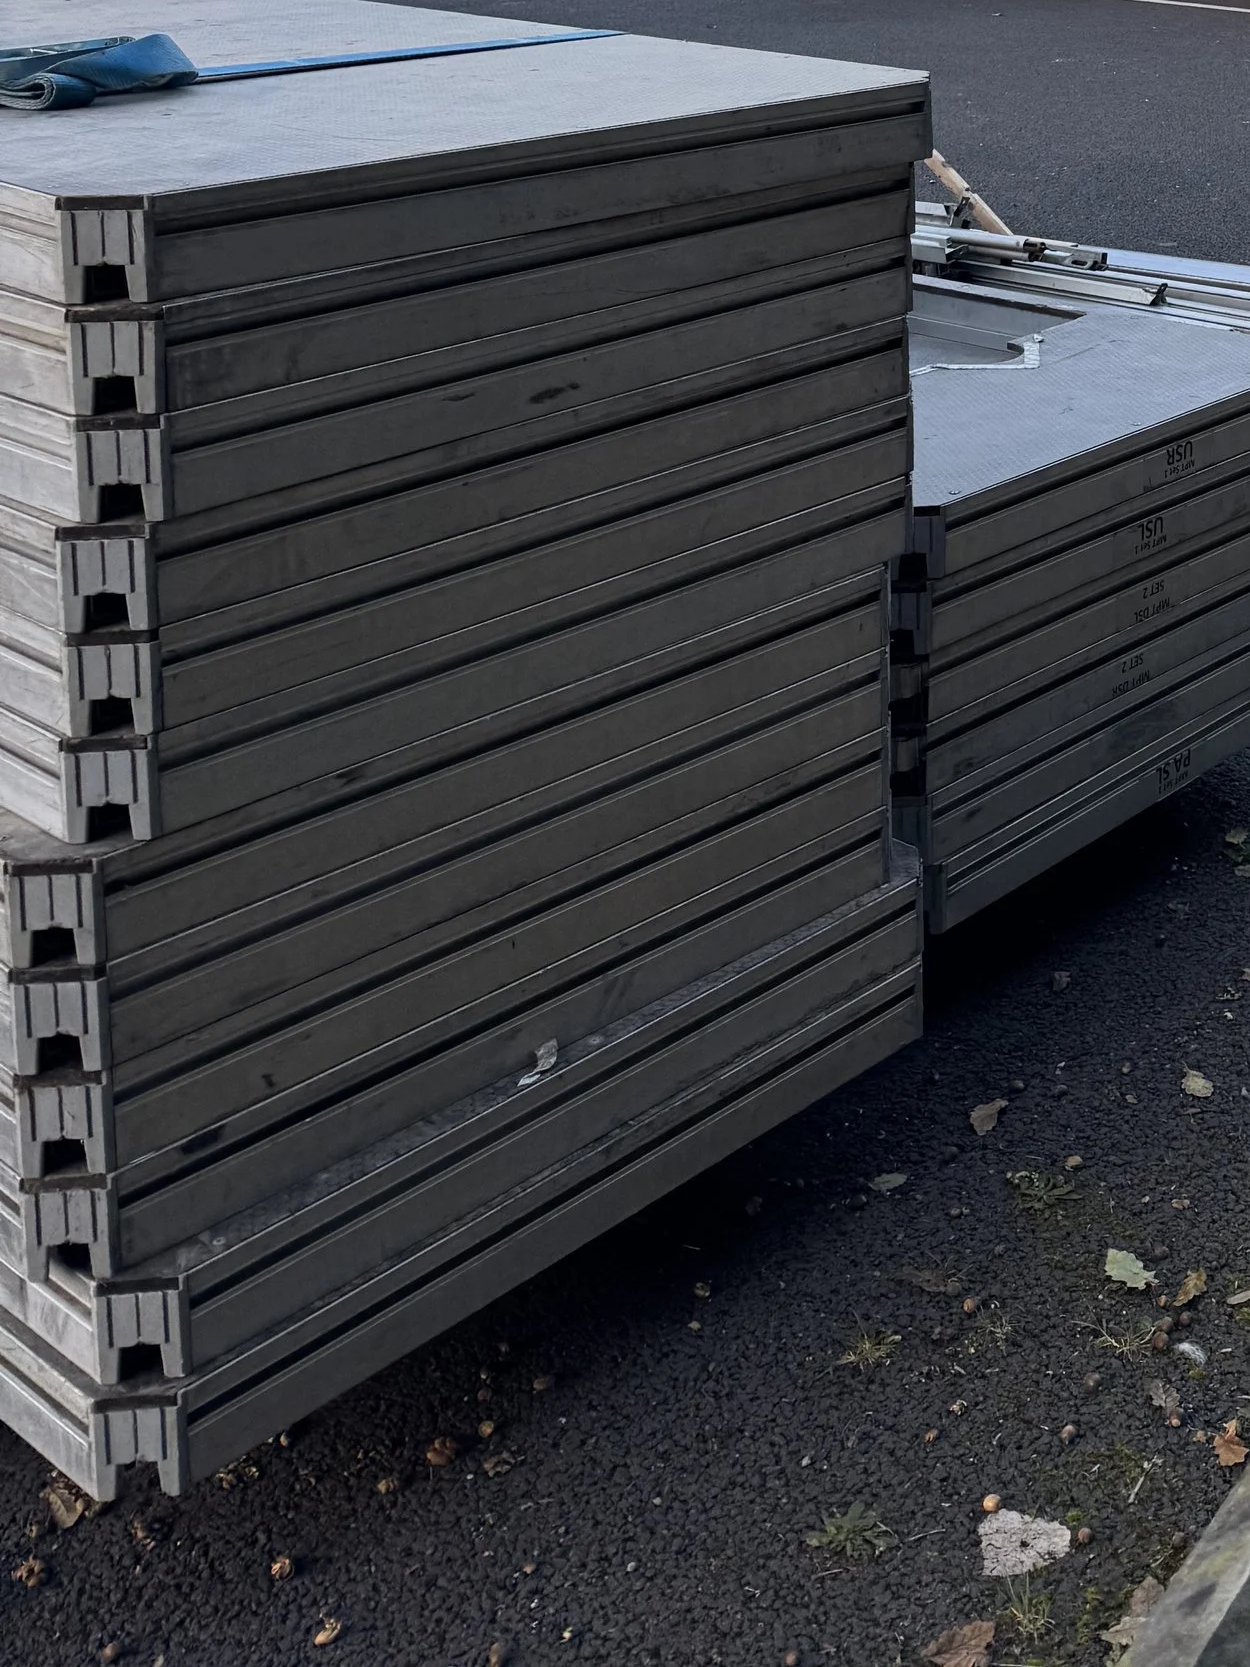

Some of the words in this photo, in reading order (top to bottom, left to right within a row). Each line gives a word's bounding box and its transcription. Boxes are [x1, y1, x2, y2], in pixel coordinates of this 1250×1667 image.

[1166, 440, 1193, 466] USR
[1169, 464, 1180, 476] Set
[1181, 459, 1195, 472] MPT
[1137, 516, 1163, 542] USL
[1152, 534, 1167, 548] MPT
[1142, 587, 1148, 600] 2
[1149, 579, 1165, 597] SET
[1152, 597, 1170, 615] MPT
[1121, 660, 1127, 674] 2
[1129, 653, 1144, 670] SET
[1132, 669, 1150, 687] MPT
[1174, 749, 1191, 773] PA
[1156, 762, 1170, 785] SL
